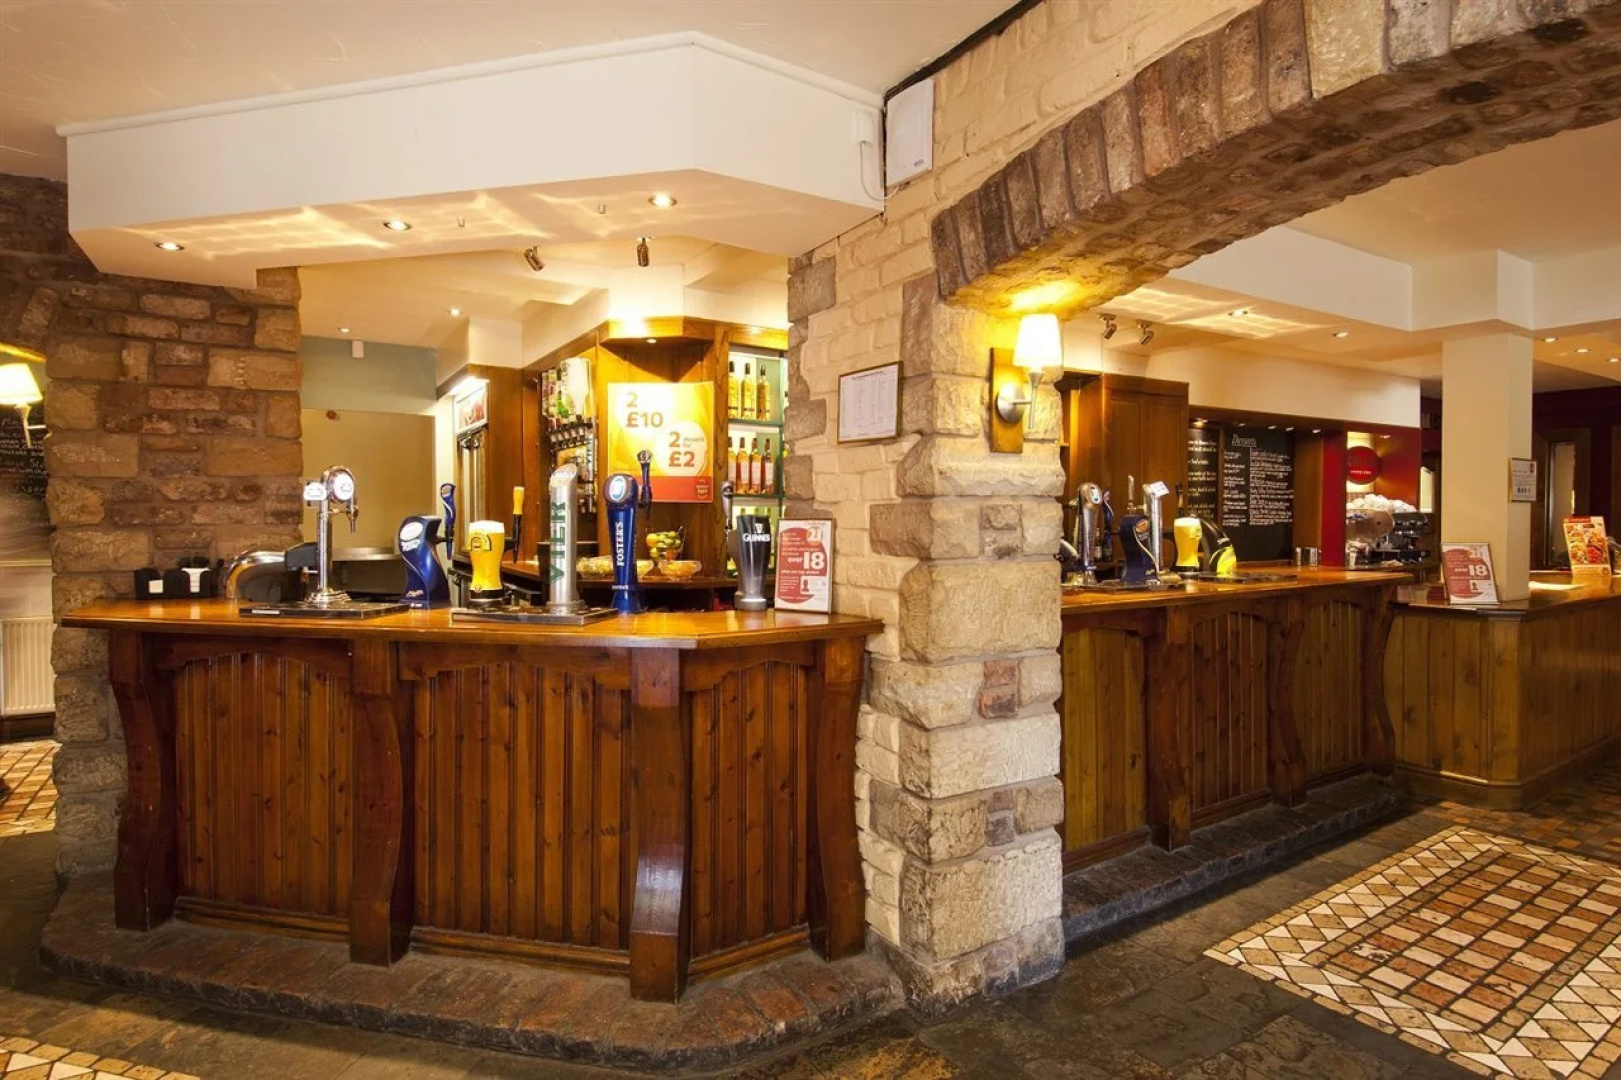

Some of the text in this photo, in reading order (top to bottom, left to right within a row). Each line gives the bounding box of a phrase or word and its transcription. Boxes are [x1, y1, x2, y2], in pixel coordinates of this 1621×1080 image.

[626, 391, 638, 408] 2
[626, 412, 664, 428] £10
[669, 431, 681, 448] 2
[668, 451, 695, 467] £2
[549, 501, 566, 583] VIER
[615, 521, 625, 567] FOSTER'S
[803, 551, 825, 570] 18
[1468, 564, 1489, 576] 18
